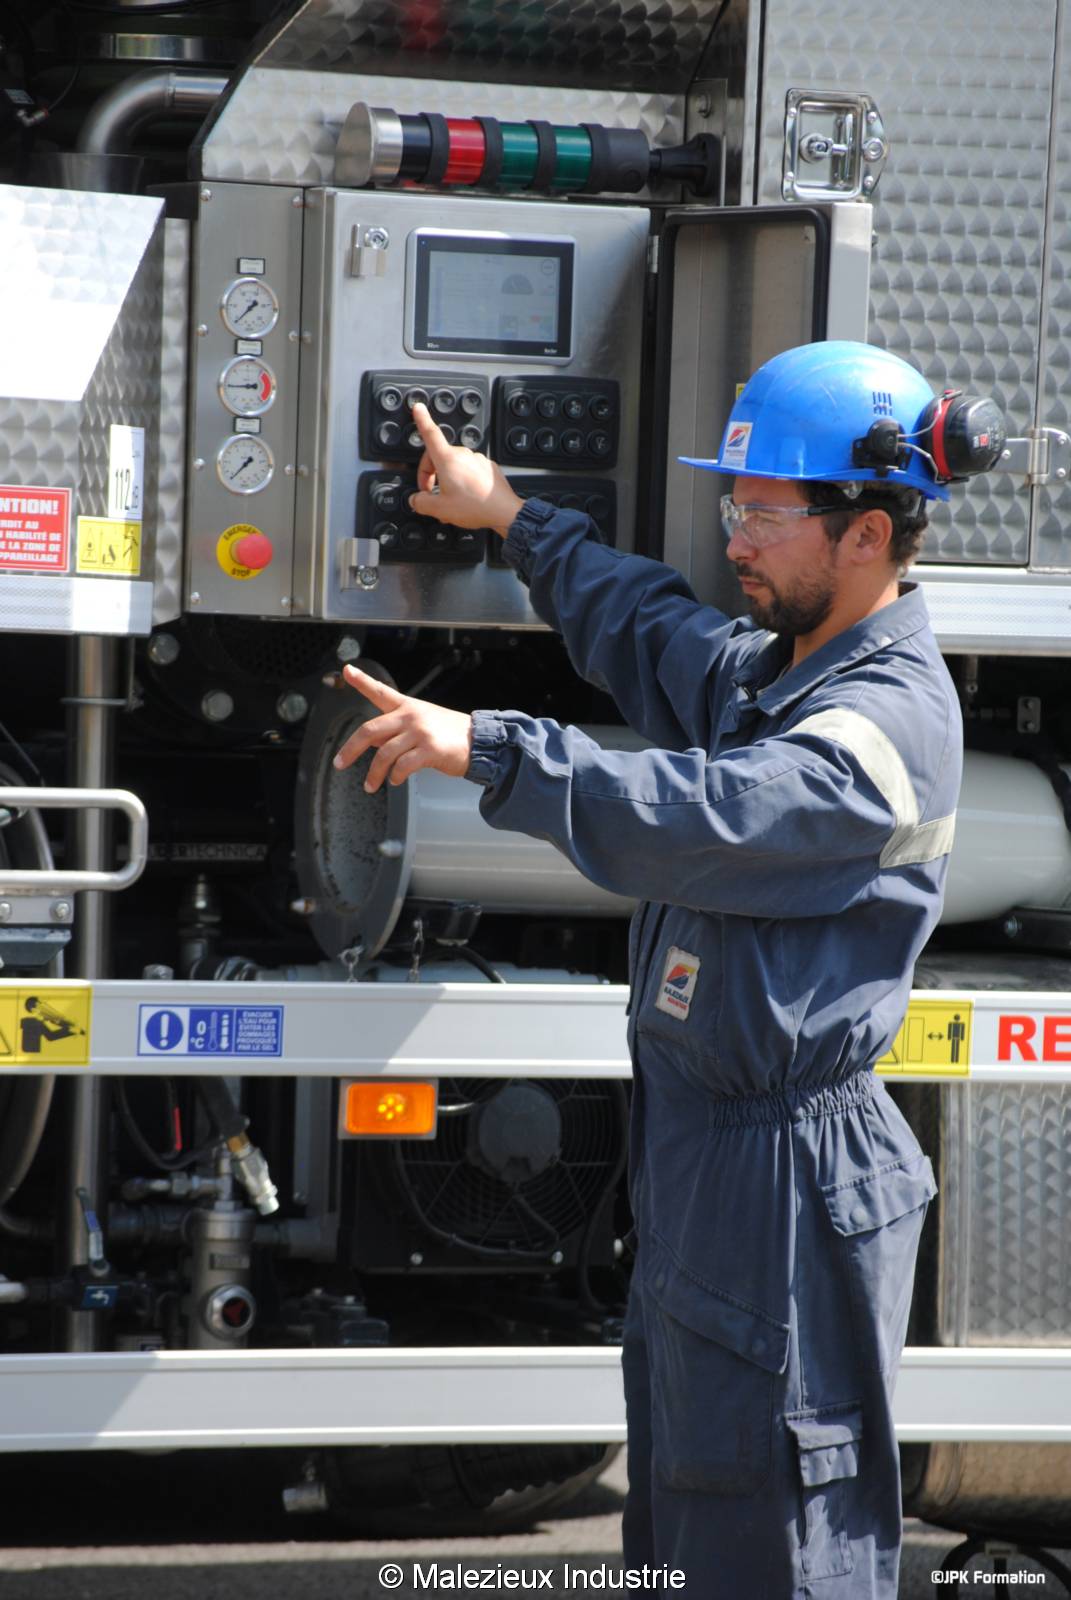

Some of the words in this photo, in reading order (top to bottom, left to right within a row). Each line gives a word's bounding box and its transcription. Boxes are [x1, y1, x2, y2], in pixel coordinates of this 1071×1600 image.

[25, 521, 39, 529] AU
[8, 541, 20, 549] LA
[22, 542, 46, 551] ZONE
[48, 543, 61, 552] DE
[196, 1020, 206, 1036] 0
[998, 1015, 1071, 1062] RE
